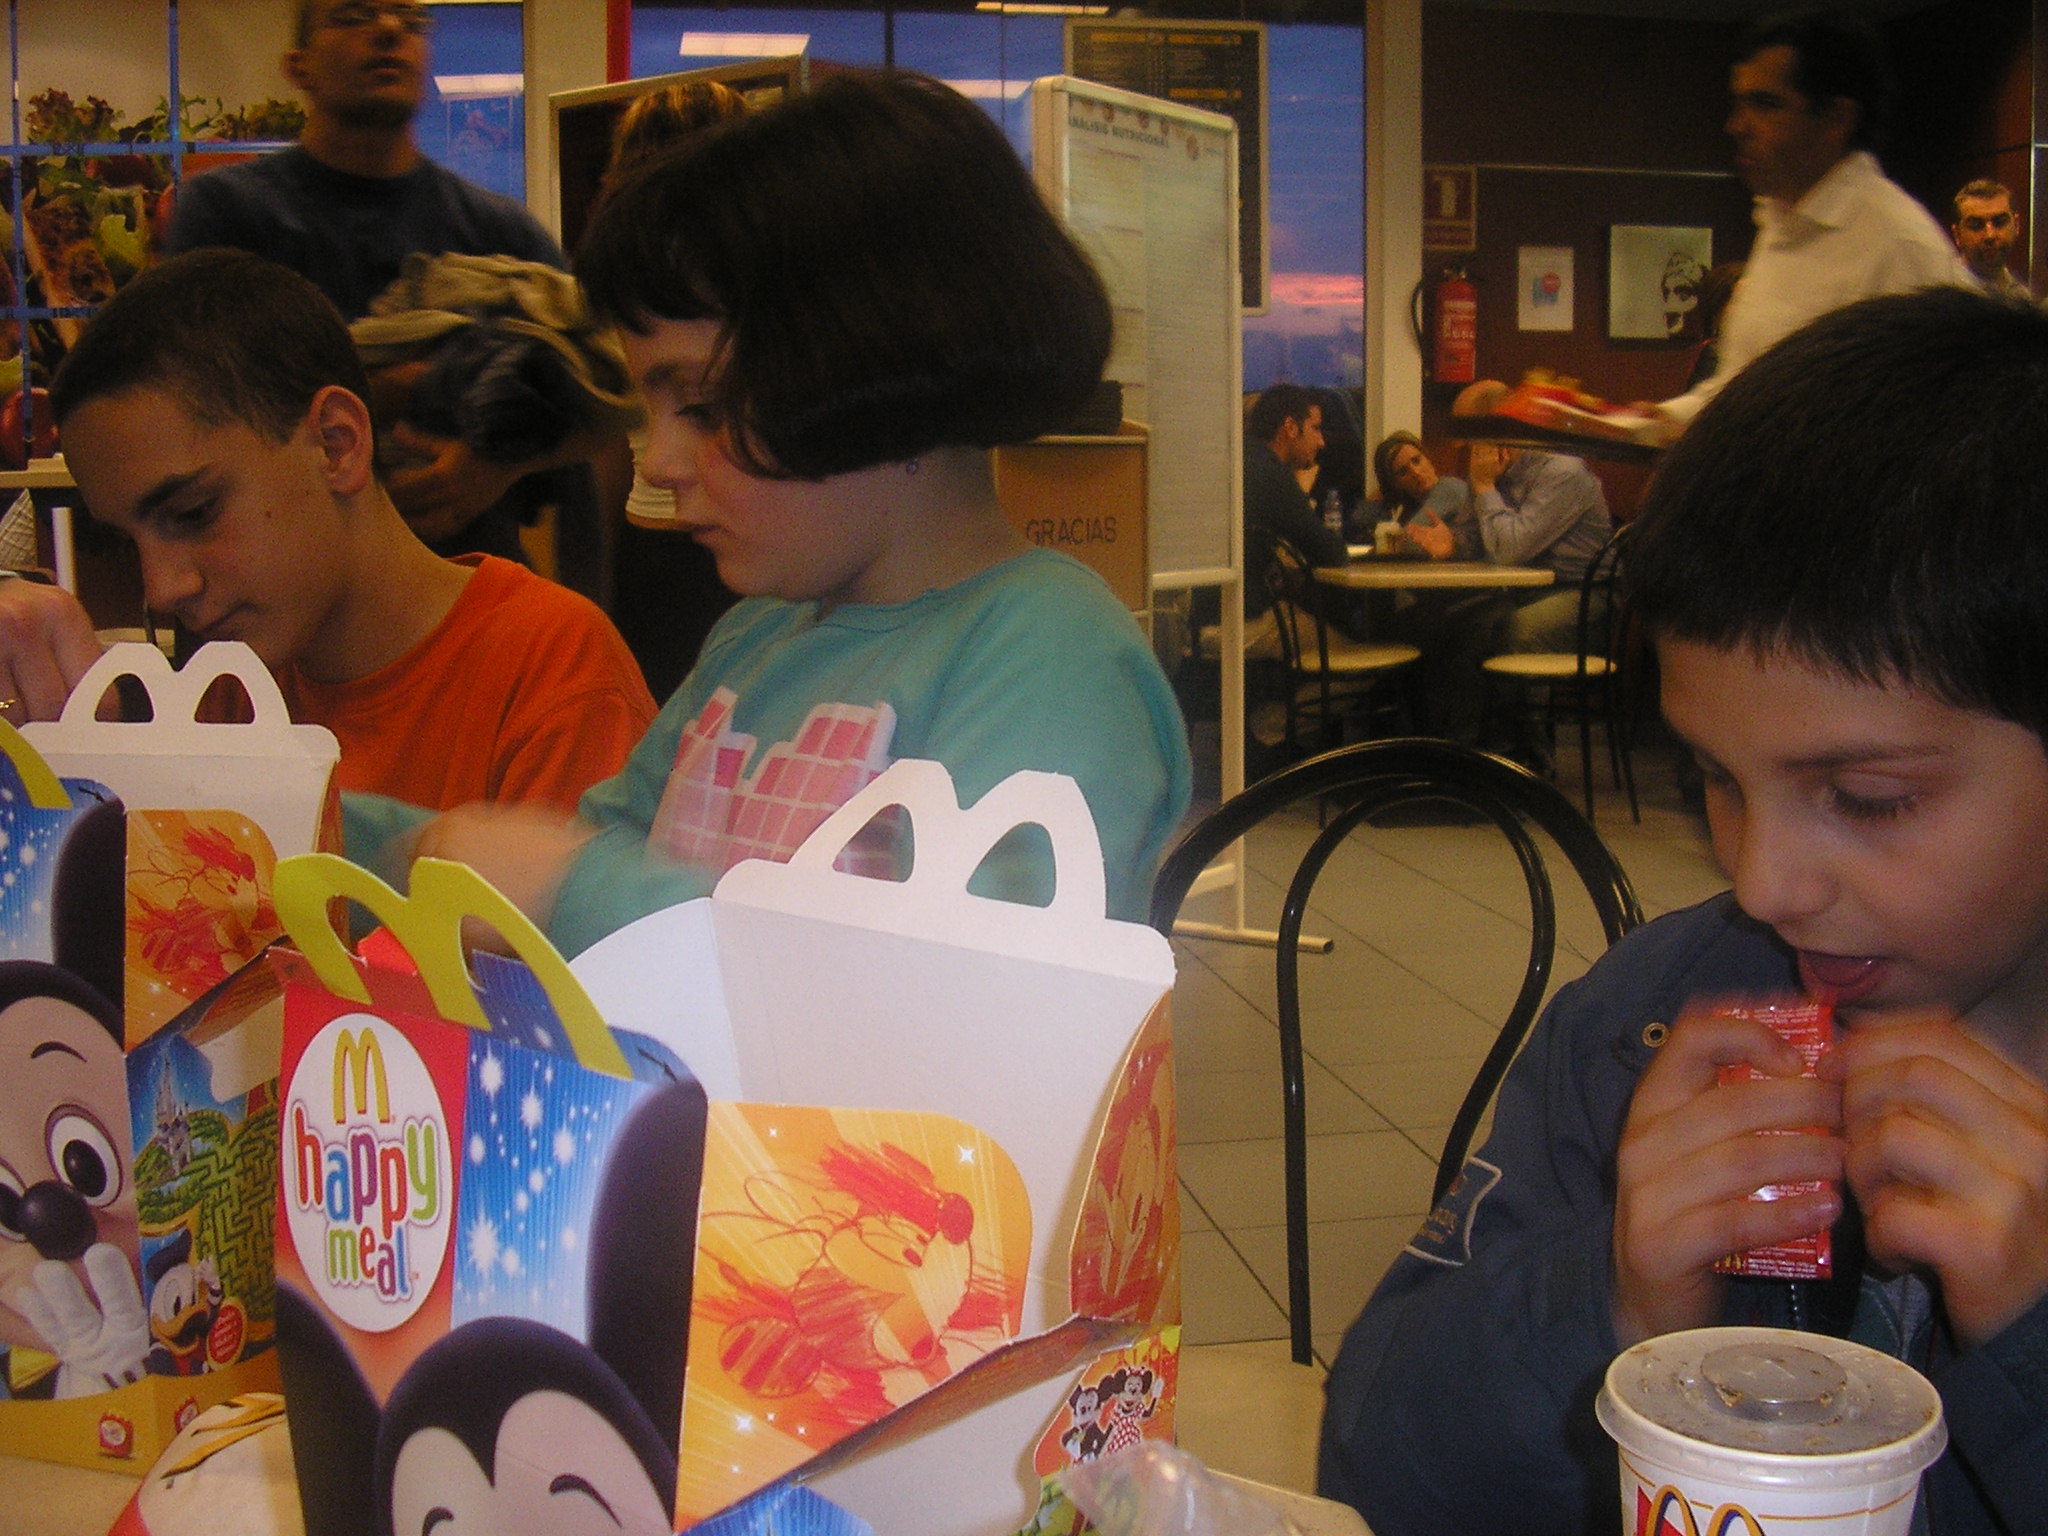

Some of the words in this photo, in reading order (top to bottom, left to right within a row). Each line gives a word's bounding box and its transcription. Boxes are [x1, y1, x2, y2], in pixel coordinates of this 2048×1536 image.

[1026, 517, 1118, 546] GRACIAS
[294, 1106, 437, 1240] happy
[328, 1225, 409, 1297] meal
